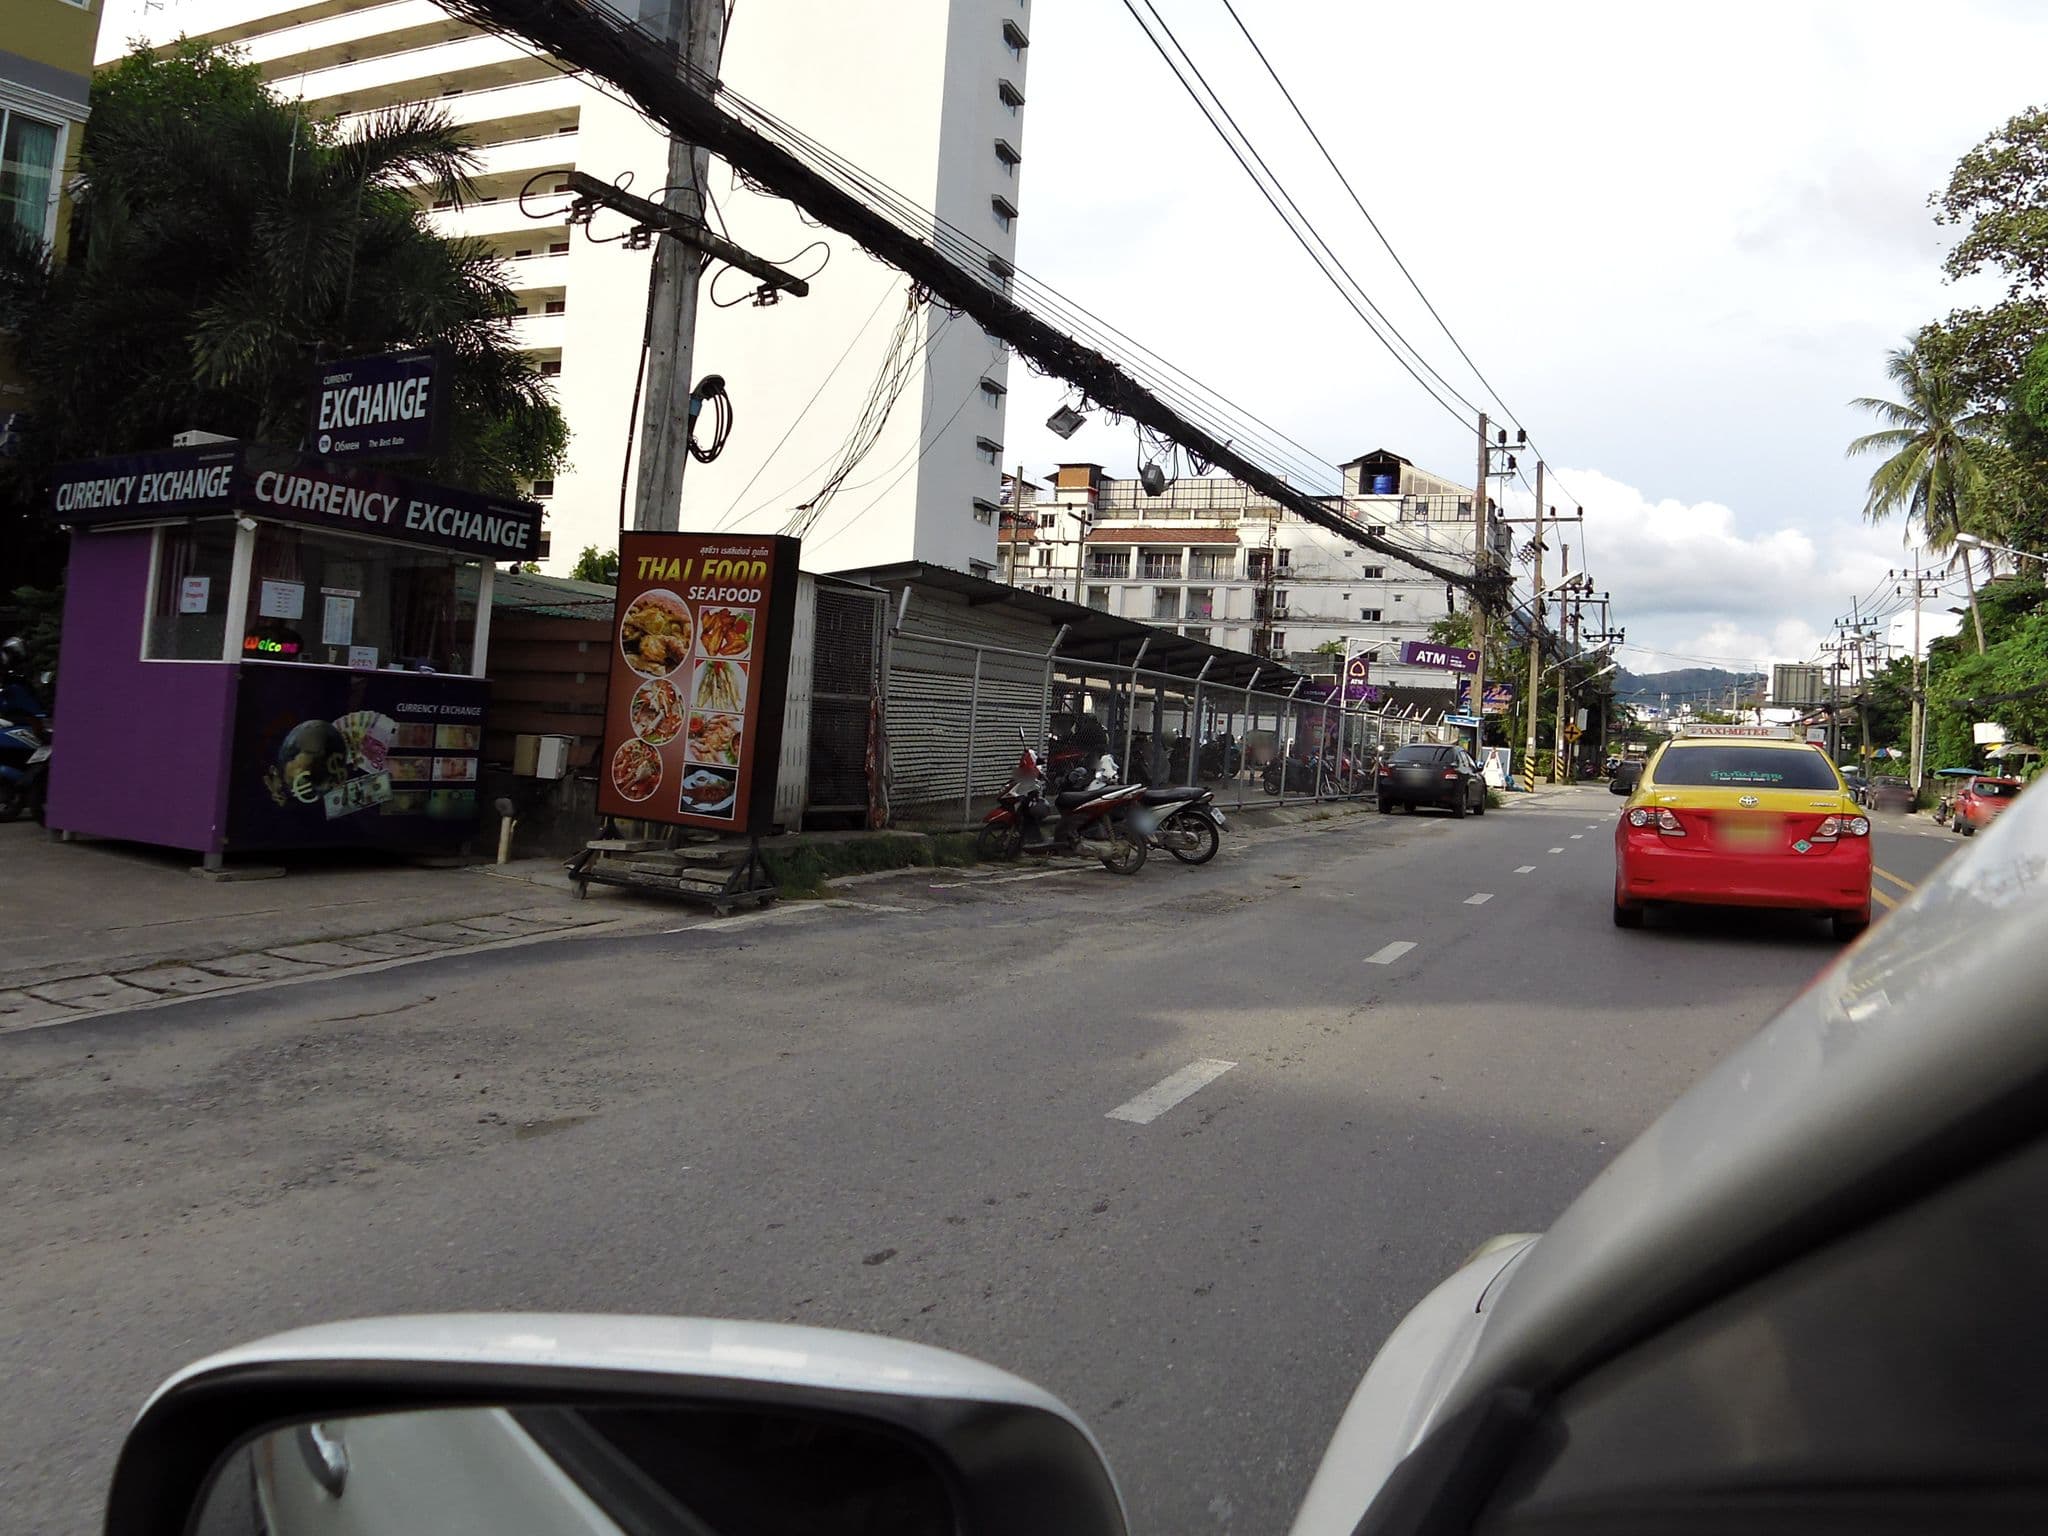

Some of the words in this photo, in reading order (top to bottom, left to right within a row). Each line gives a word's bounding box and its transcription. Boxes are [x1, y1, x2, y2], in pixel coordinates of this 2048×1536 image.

[323, 373, 352, 385] CURRENCY
[319, 377, 430, 430] EXCHANGE
[56, 476, 136, 512] CURRENCY
[138, 465, 234, 504] EXCHANGE
[255, 470, 400, 524] CURRENCY
[405, 500, 531, 549] EXCHANGE
[637, 556, 694, 582] THAI
[701, 558, 767, 584] FOOD
[687, 586, 762, 604] SEAFOOD
[1416, 650, 1446, 665] ATM
[397, 703, 439, 714] CURRENCY
[440, 704, 482, 716] EXCHANGE
